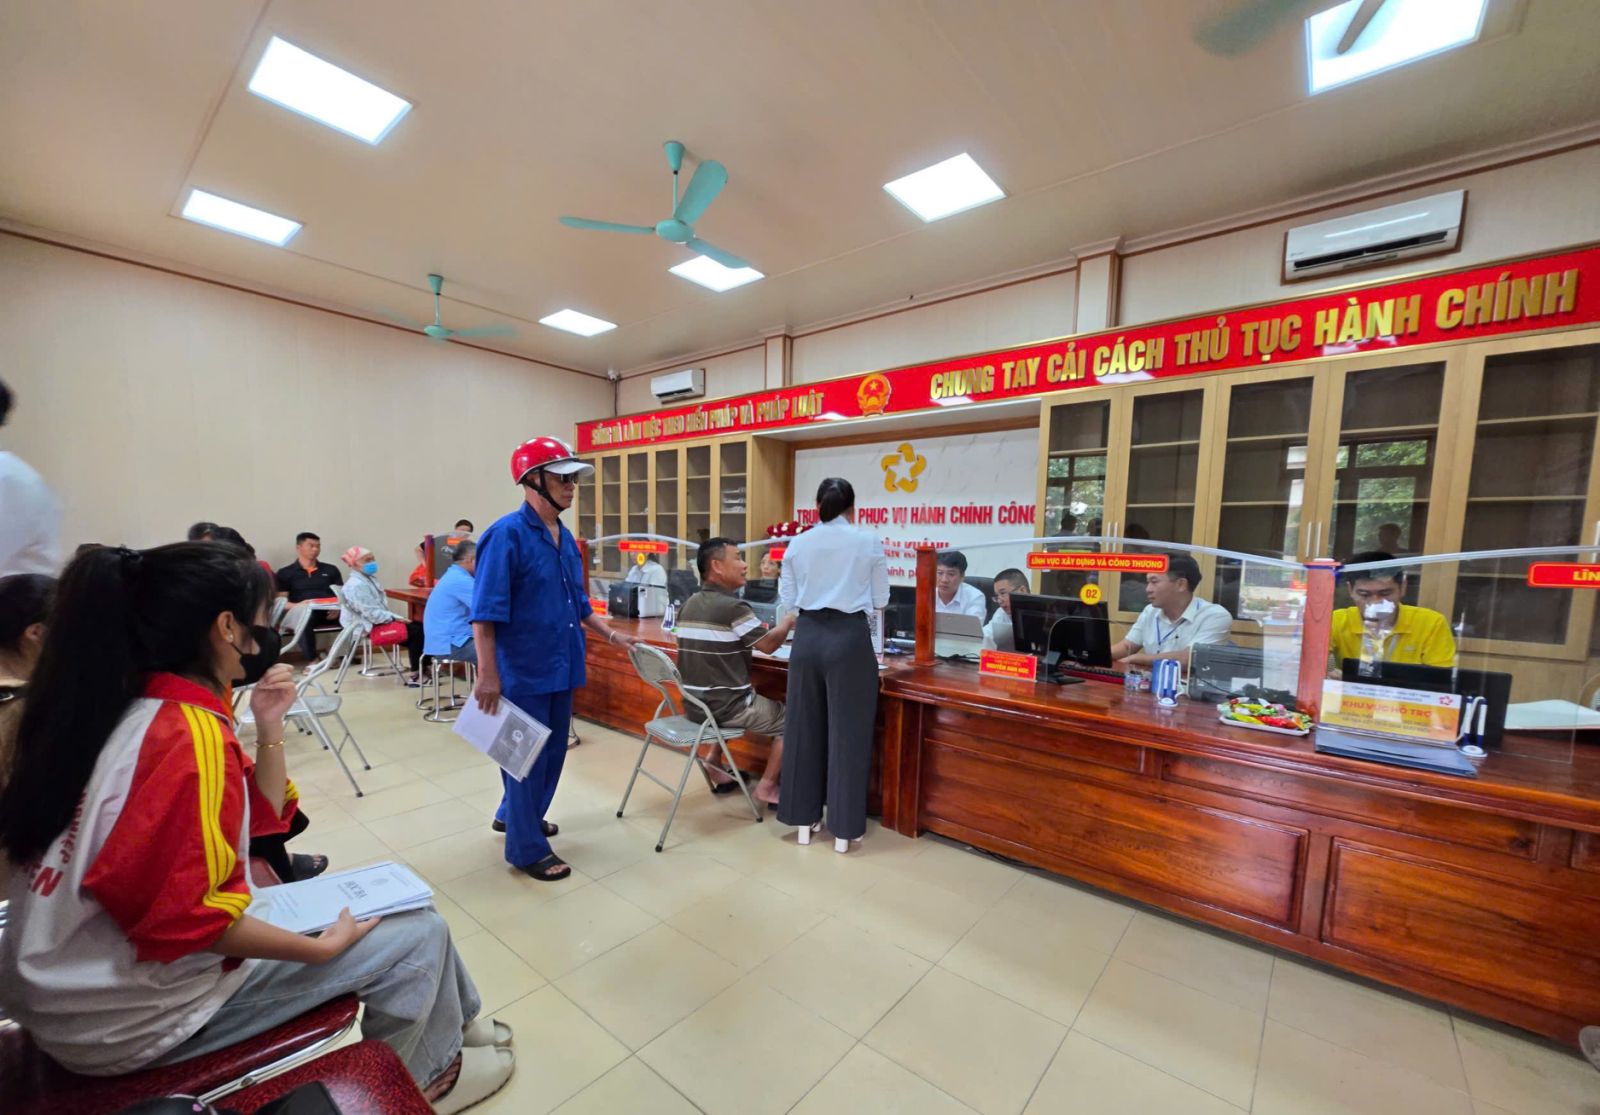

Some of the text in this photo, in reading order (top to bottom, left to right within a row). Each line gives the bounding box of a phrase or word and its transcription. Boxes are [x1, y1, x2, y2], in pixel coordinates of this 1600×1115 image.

[930, 269, 1580, 400] CHUNG TAY CẢI CÁCH THỦ TỤC HÀNH CHÍNH
[709, 404, 738, 429] PHÁP
[740, 400, 754, 425] VÀ
[756, 395, 789, 423] PHÁP
[792, 389, 824, 420] LUẬT
[797, 508, 820, 525] TRU
[858, 507, 889, 529] PHỤC
[892, 507, 908, 528] VỤ
[910, 502, 946, 524] HÀNH
[950, 501, 993, 524] CHÍNH
[1061, 557, 1074, 567] XÂY
[1076, 558, 1095, 568] DỰNG
[1096, 558, 1107, 567] VÀ
[1108, 558, 1131, 567] CÔNG
[1132, 560, 1163, 569] THƯƠNG
[1085, 588, 1097, 599] 02
[1342, 700, 1365, 709] KHU
